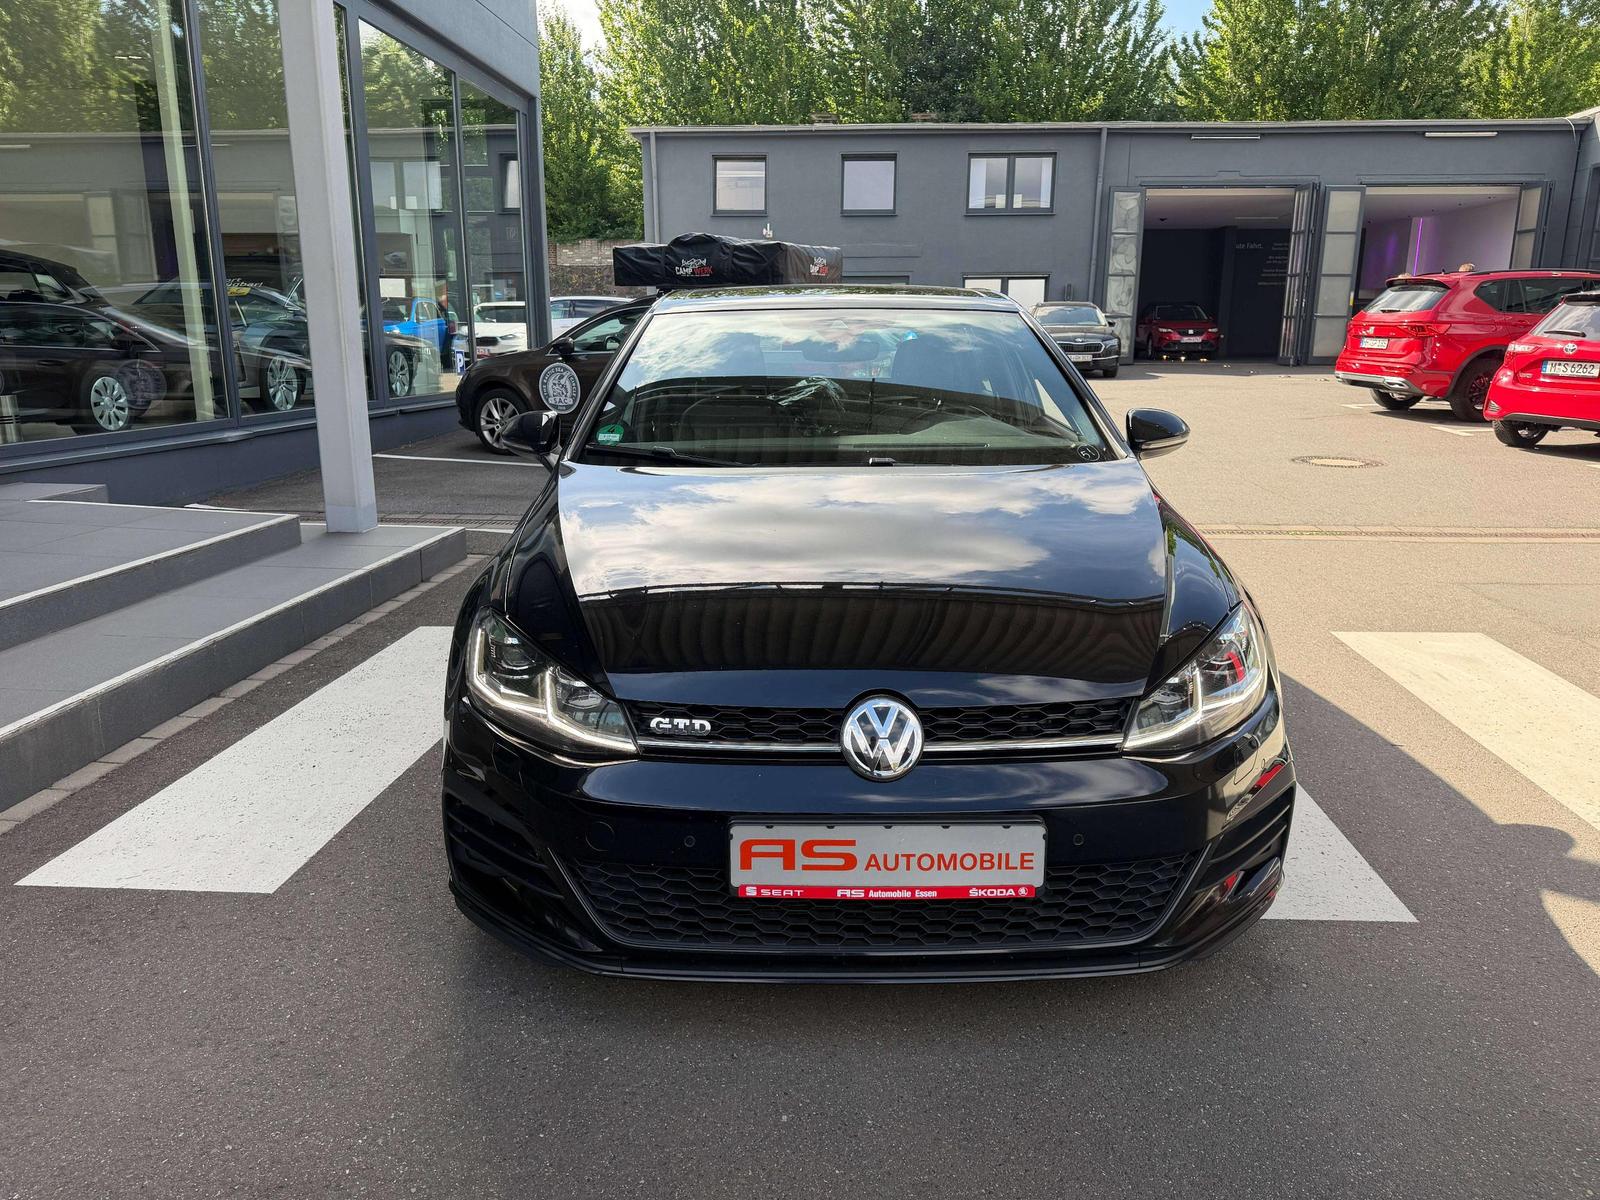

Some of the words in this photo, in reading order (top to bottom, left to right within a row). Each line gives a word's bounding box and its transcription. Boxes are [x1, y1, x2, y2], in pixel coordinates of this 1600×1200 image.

[650, 717, 712, 736] GTD
[739, 838, 858, 871] AS
[864, 852, 1035, 872] AUTOMOBILE
[760, 889, 804, 897] SEAT
[836, 889, 865, 898] AS
[868, 889, 911, 898] Automobile
[915, 889, 937, 898] Essen
[969, 887, 1015, 897] ŠKODA
